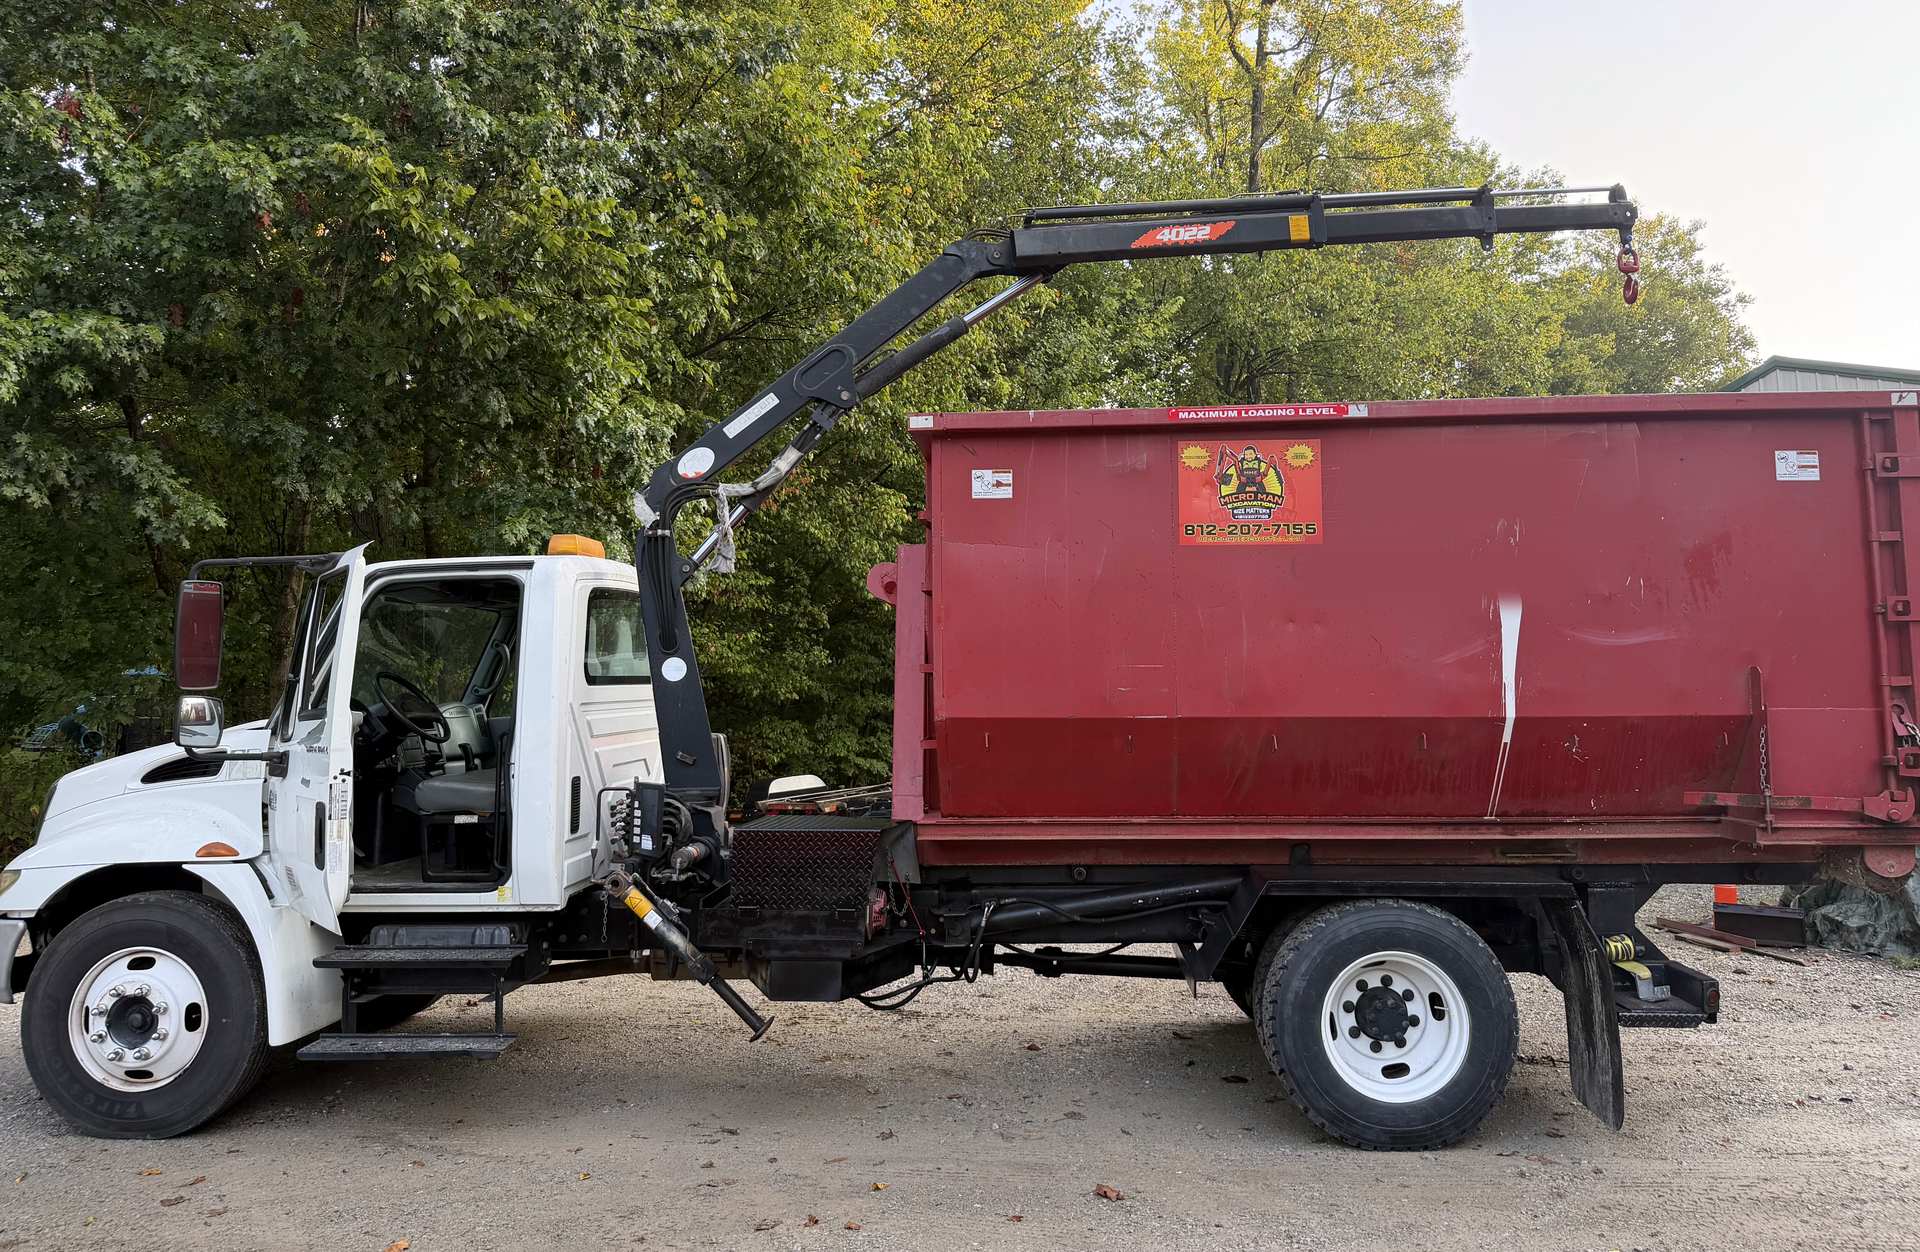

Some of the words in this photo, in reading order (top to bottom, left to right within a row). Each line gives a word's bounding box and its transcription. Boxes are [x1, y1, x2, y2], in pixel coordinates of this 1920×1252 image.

[1156, 226, 1211, 241] 4022
[1178, 409, 1238, 419] MAXIMUM
[1241, 407, 1295, 417] LOADING
[1298, 406, 1337, 416] LEVEL
[1220, 493, 1255, 505] MICRO
[1257, 493, 1283, 505] MAN
[1227, 501, 1276, 509] EXCAVATION
[1184, 522, 1317, 536] 812-207-7155
